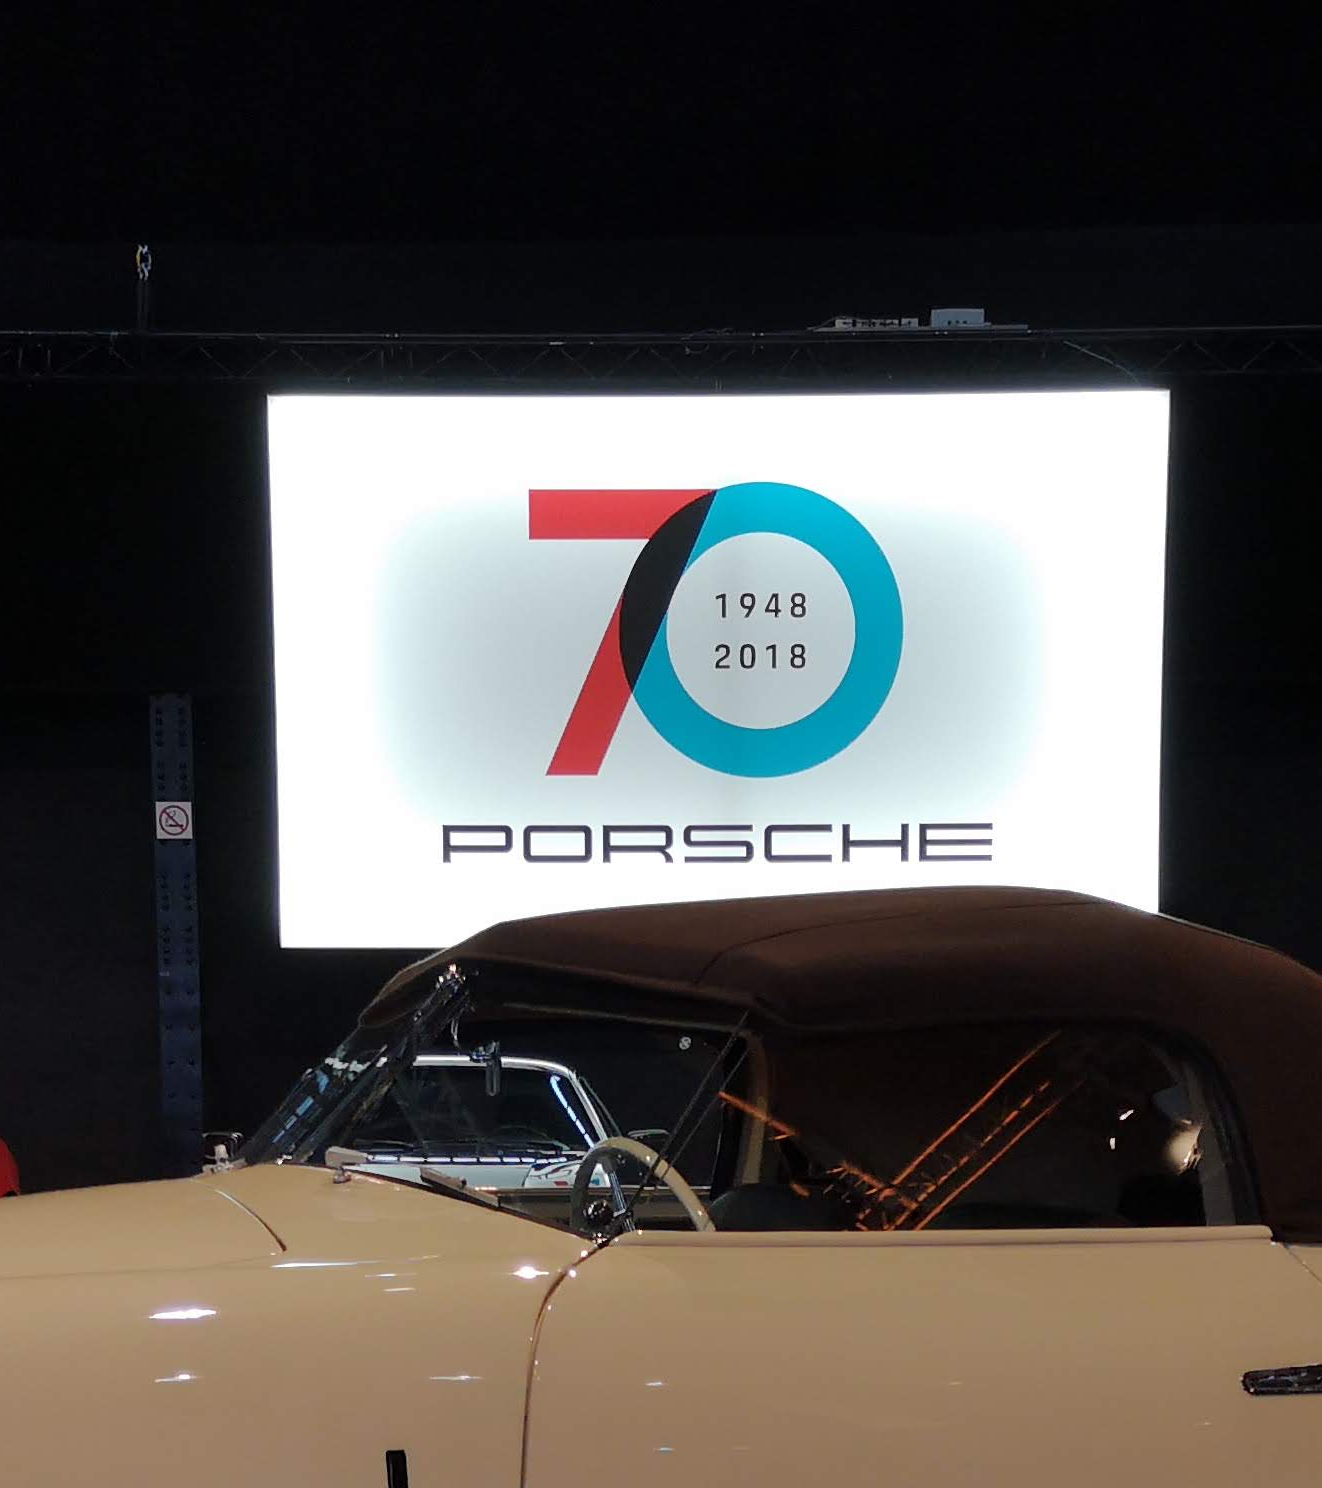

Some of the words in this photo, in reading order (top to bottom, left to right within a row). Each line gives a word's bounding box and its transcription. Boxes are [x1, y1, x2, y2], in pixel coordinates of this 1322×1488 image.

[715, 592, 809, 619] 1948
[529, 481, 903, 778] 70
[714, 643, 809, 670] 2018
[442, 822, 994, 864] PORSCHE
